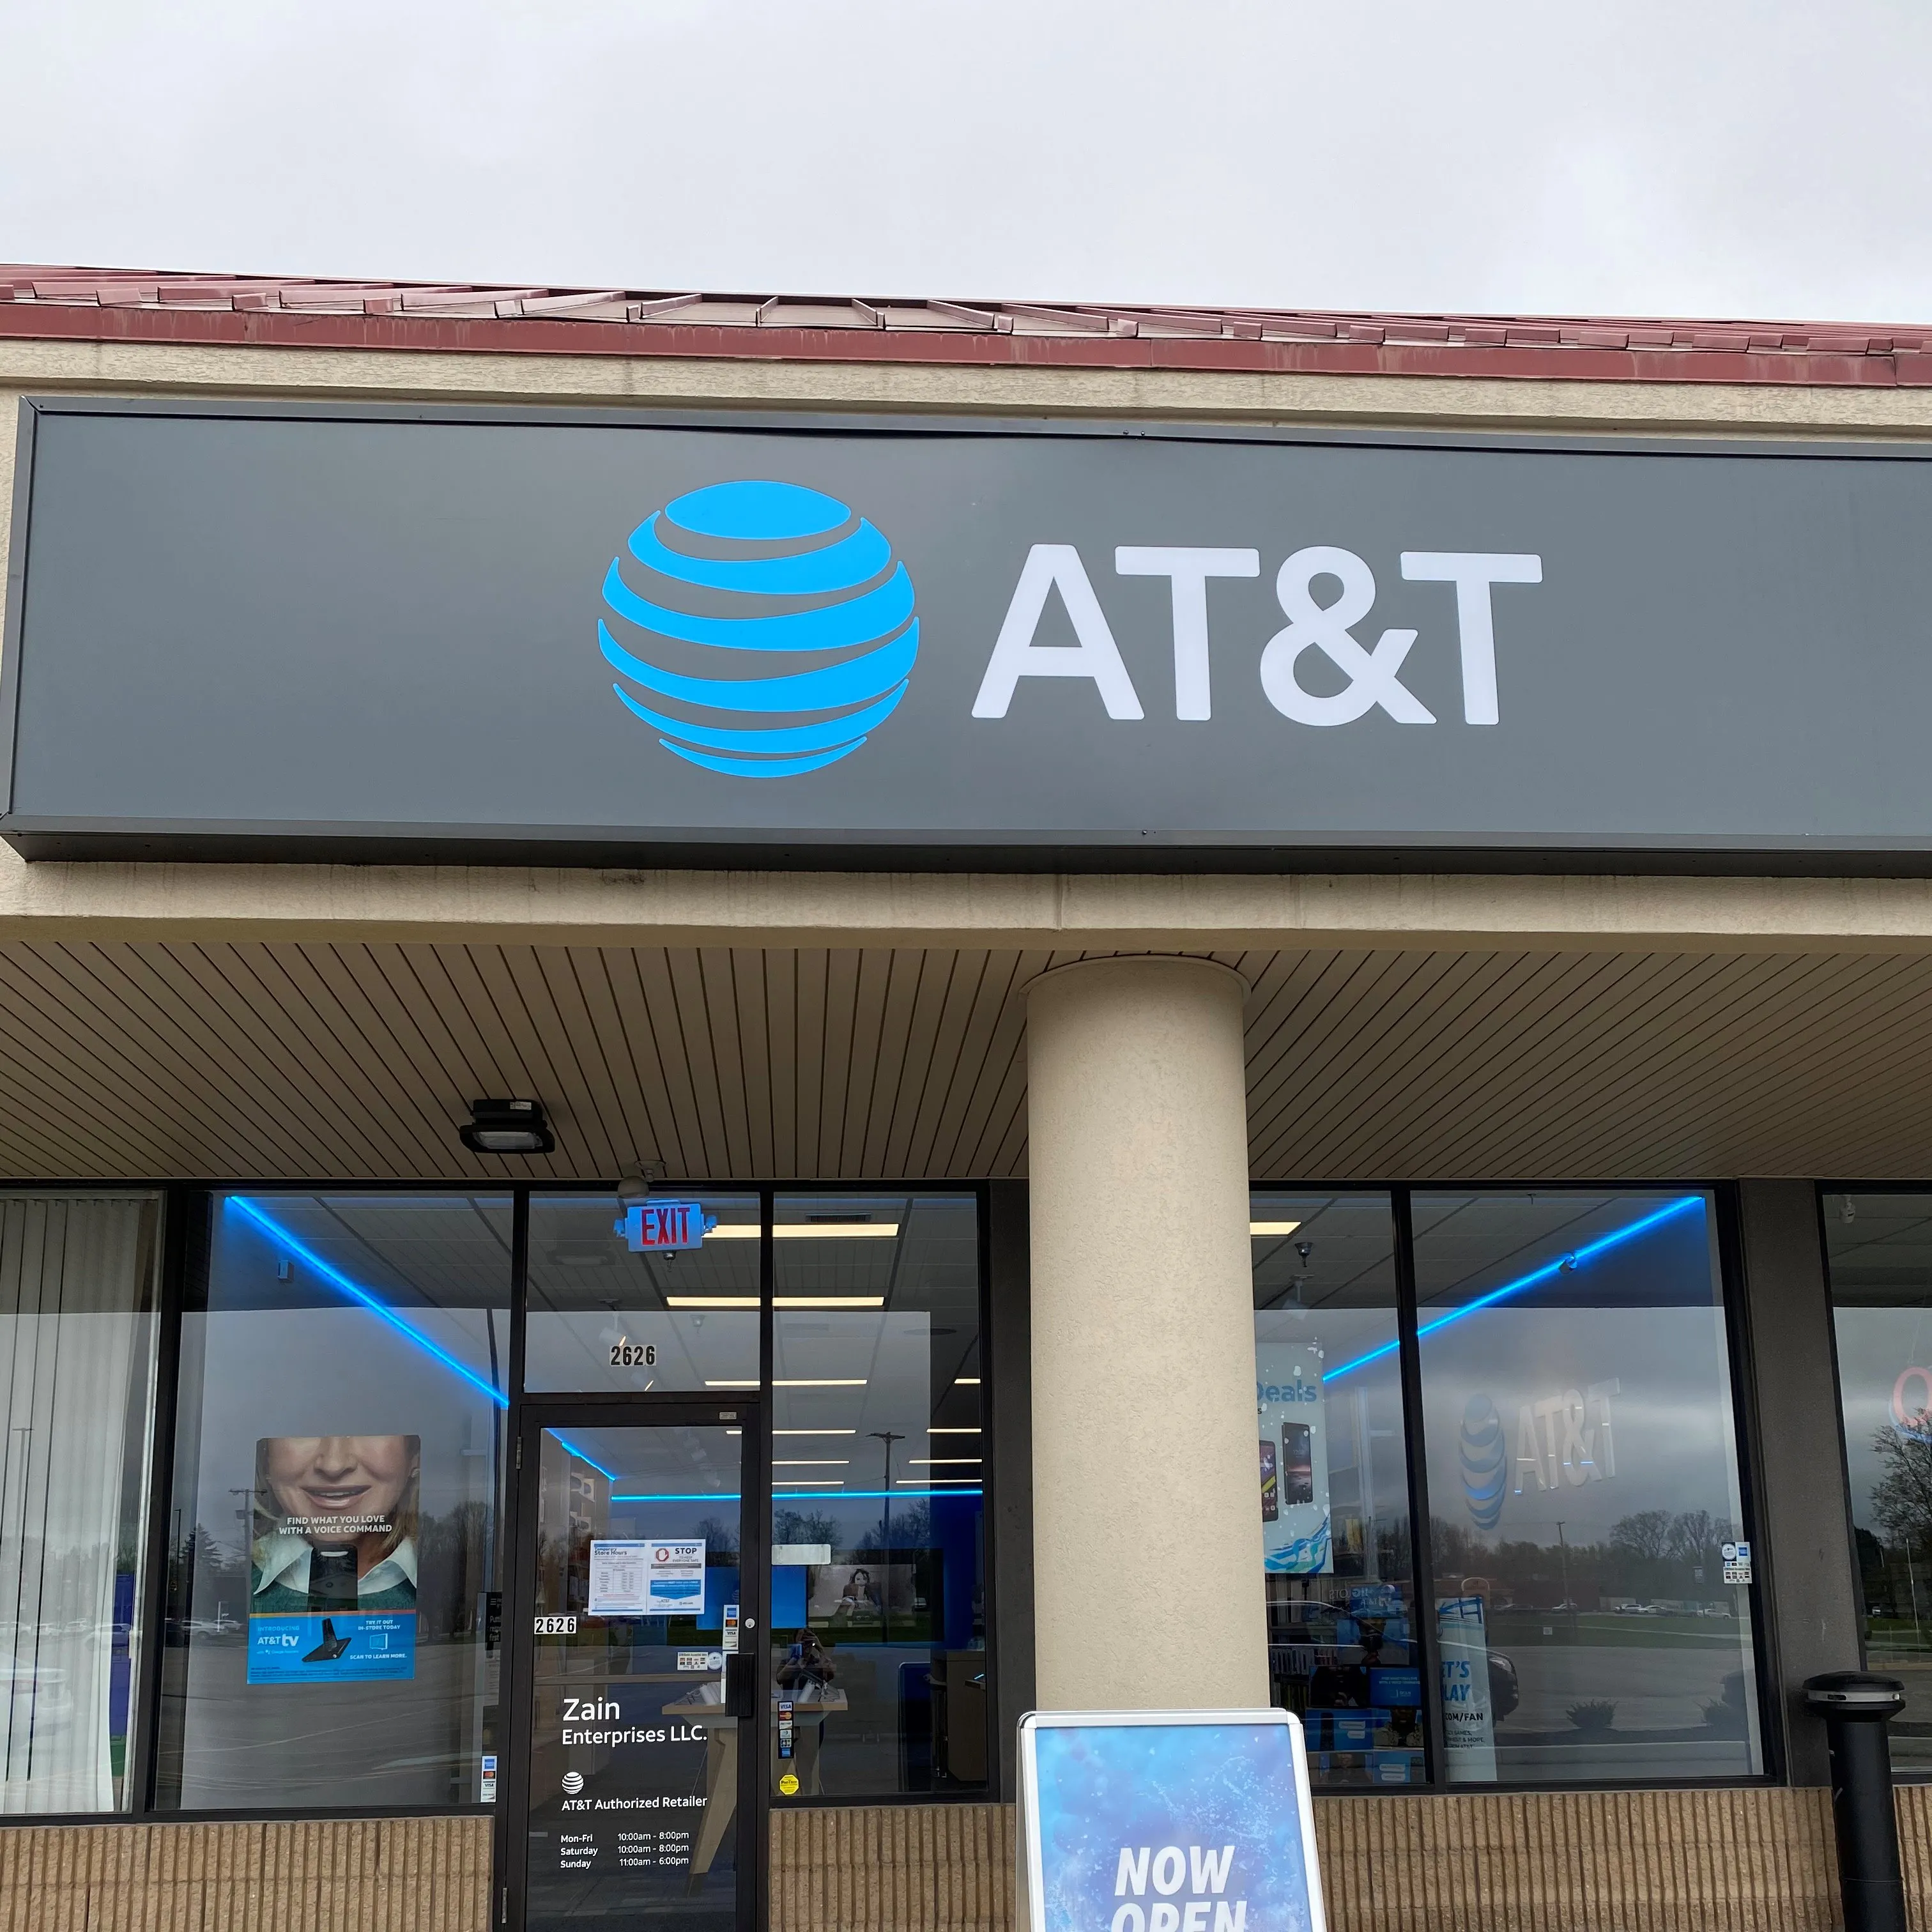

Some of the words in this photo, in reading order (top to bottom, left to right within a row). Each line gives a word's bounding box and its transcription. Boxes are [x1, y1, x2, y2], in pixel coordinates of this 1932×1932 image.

[971, 544, 1542, 726] AT&T
[641, 1207, 690, 1246] EXIT
[610, 1345, 655, 1366] 2626
[1514, 1377, 1620, 1495] AT&T
[287, 1517, 309, 1525] FIND
[310, 1516, 337, 1524] WHAT
[340, 1515, 359, 1524] YOU
[361, 1515, 385, 1523] LOVE
[279, 1526, 303, 1535] WITH
[314, 1526, 341, 1534] VOICE
[343, 1524, 392, 1533] COMMAND
[535, 1618, 575, 1633] 2626
[257, 1636, 282, 1645] AT&T
[281, 1633, 300, 1647] tv
[562, 1696, 620, 1722] Zain
[562, 1726, 666, 1748] Enterprises
[670, 1725, 708, 1742] LLC.
[561, 1799, 593, 1811] AT&T
[594, 1797, 660, 1810] Authorized
[663, 1795, 708, 1808] Retailer
[560, 1834, 593, 1843] Mon-Fri
[617, 1832, 651, 1841] 10:00am
[659, 1831, 689, 1841] 8:00pm
[560, 1846, 599, 1857] Saturday
[617, 1845, 651, 1854] 10:00am
[659, 1844, 689, 1853] 8:00pm
[560, 1859, 592, 1869] Sunday
[619, 1858, 651, 1866] 11:00am
[659, 1857, 689, 1867] 6:00pm
[1114, 1845, 1236, 1896] NOW
[1111, 1901, 1248, 1932] OPEN
